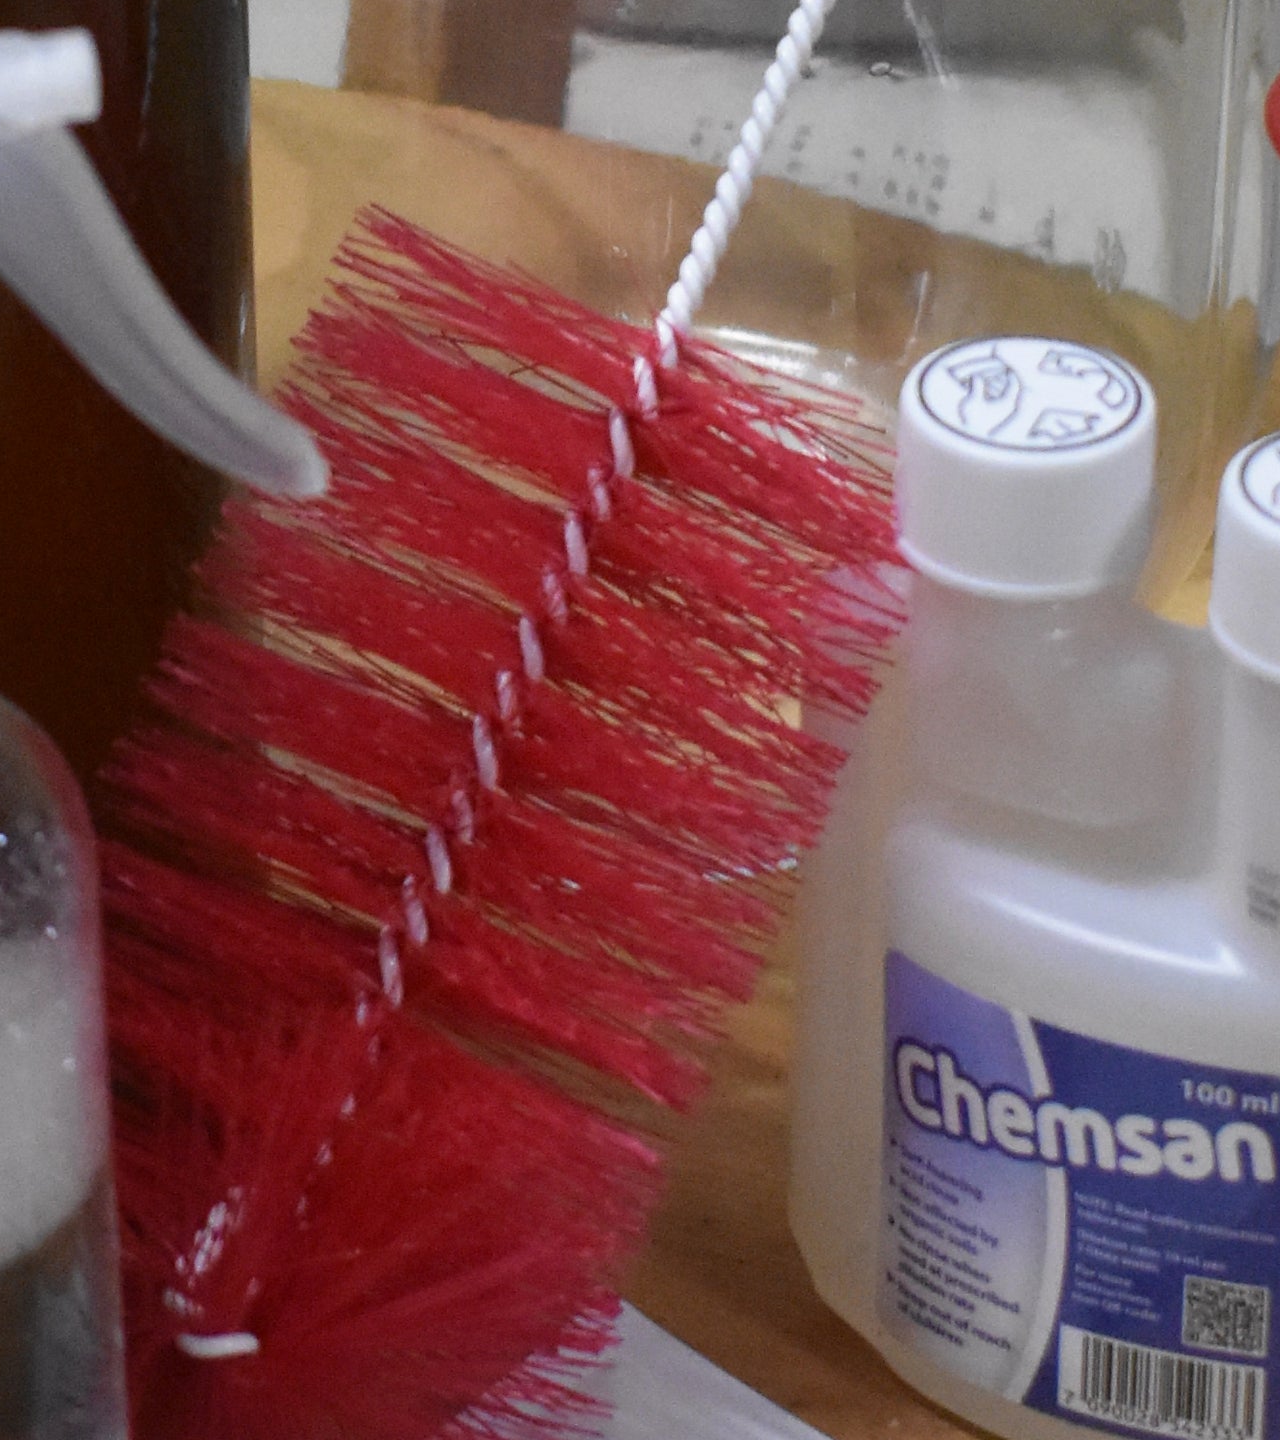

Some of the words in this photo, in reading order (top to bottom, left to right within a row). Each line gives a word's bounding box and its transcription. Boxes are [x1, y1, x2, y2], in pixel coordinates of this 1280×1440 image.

[1179, 1077, 1237, 1110] 100
[894, 1039, 1276, 1184] Chemsan
[979, 1227, 999, 1248] by
[944, 1273, 1020, 1314] prescribed
[948, 1292, 975, 1314] rate
[910, 1309, 964, 1346] children
[953, 1316, 969, 1332] of
[971, 1327, 1012, 1351] reach
[1065, 1389, 1074, 1405] 7
